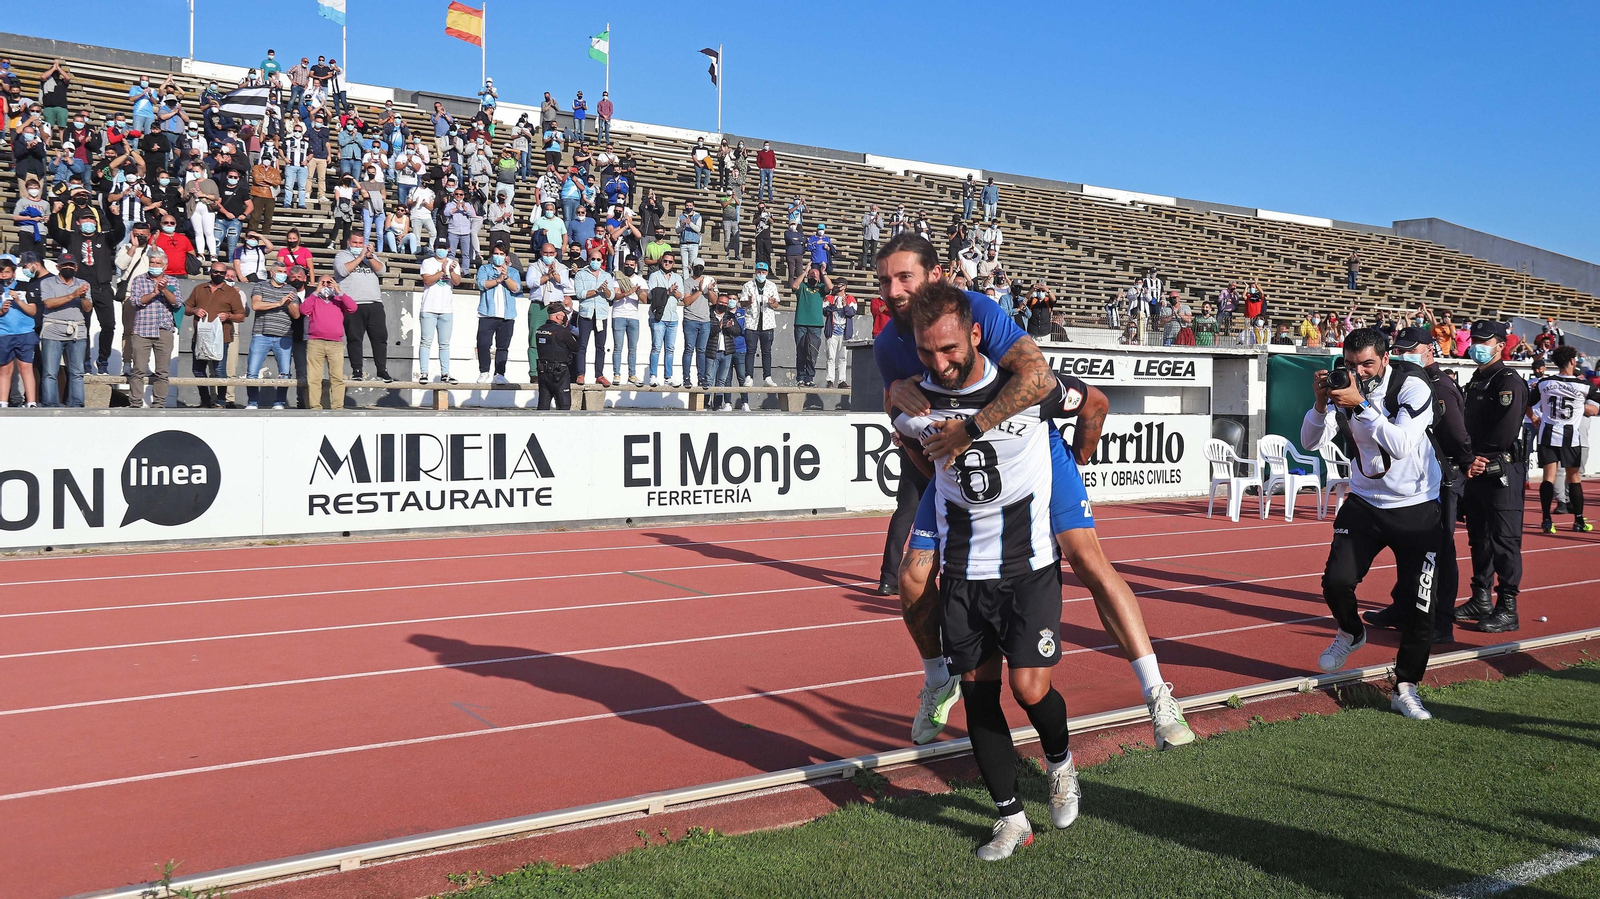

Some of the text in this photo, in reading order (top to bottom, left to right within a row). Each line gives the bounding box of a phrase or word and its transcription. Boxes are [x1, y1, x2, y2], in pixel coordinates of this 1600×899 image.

[1049, 356, 1115, 377] LEGEA
[1133, 359, 1196, 377] LEGEA
[1547, 395, 1574, 420] 15
[309, 432, 555, 485] MIREIA
[1059, 421, 1185, 466] rrillo
[129, 457, 208, 487] linea
[623, 431, 820, 495] El Monje
[953, 440, 1002, 505] 8
[1100, 471, 1108, 487] Y
[1111, 470, 1145, 487] OBRAS
[1147, 468, 1182, 485] CIVILES
[308, 486, 552, 516] RESTAURANTE
[647, 485, 752, 507] FERRETERÍA
[1416, 551, 1437, 614] LEGEA
